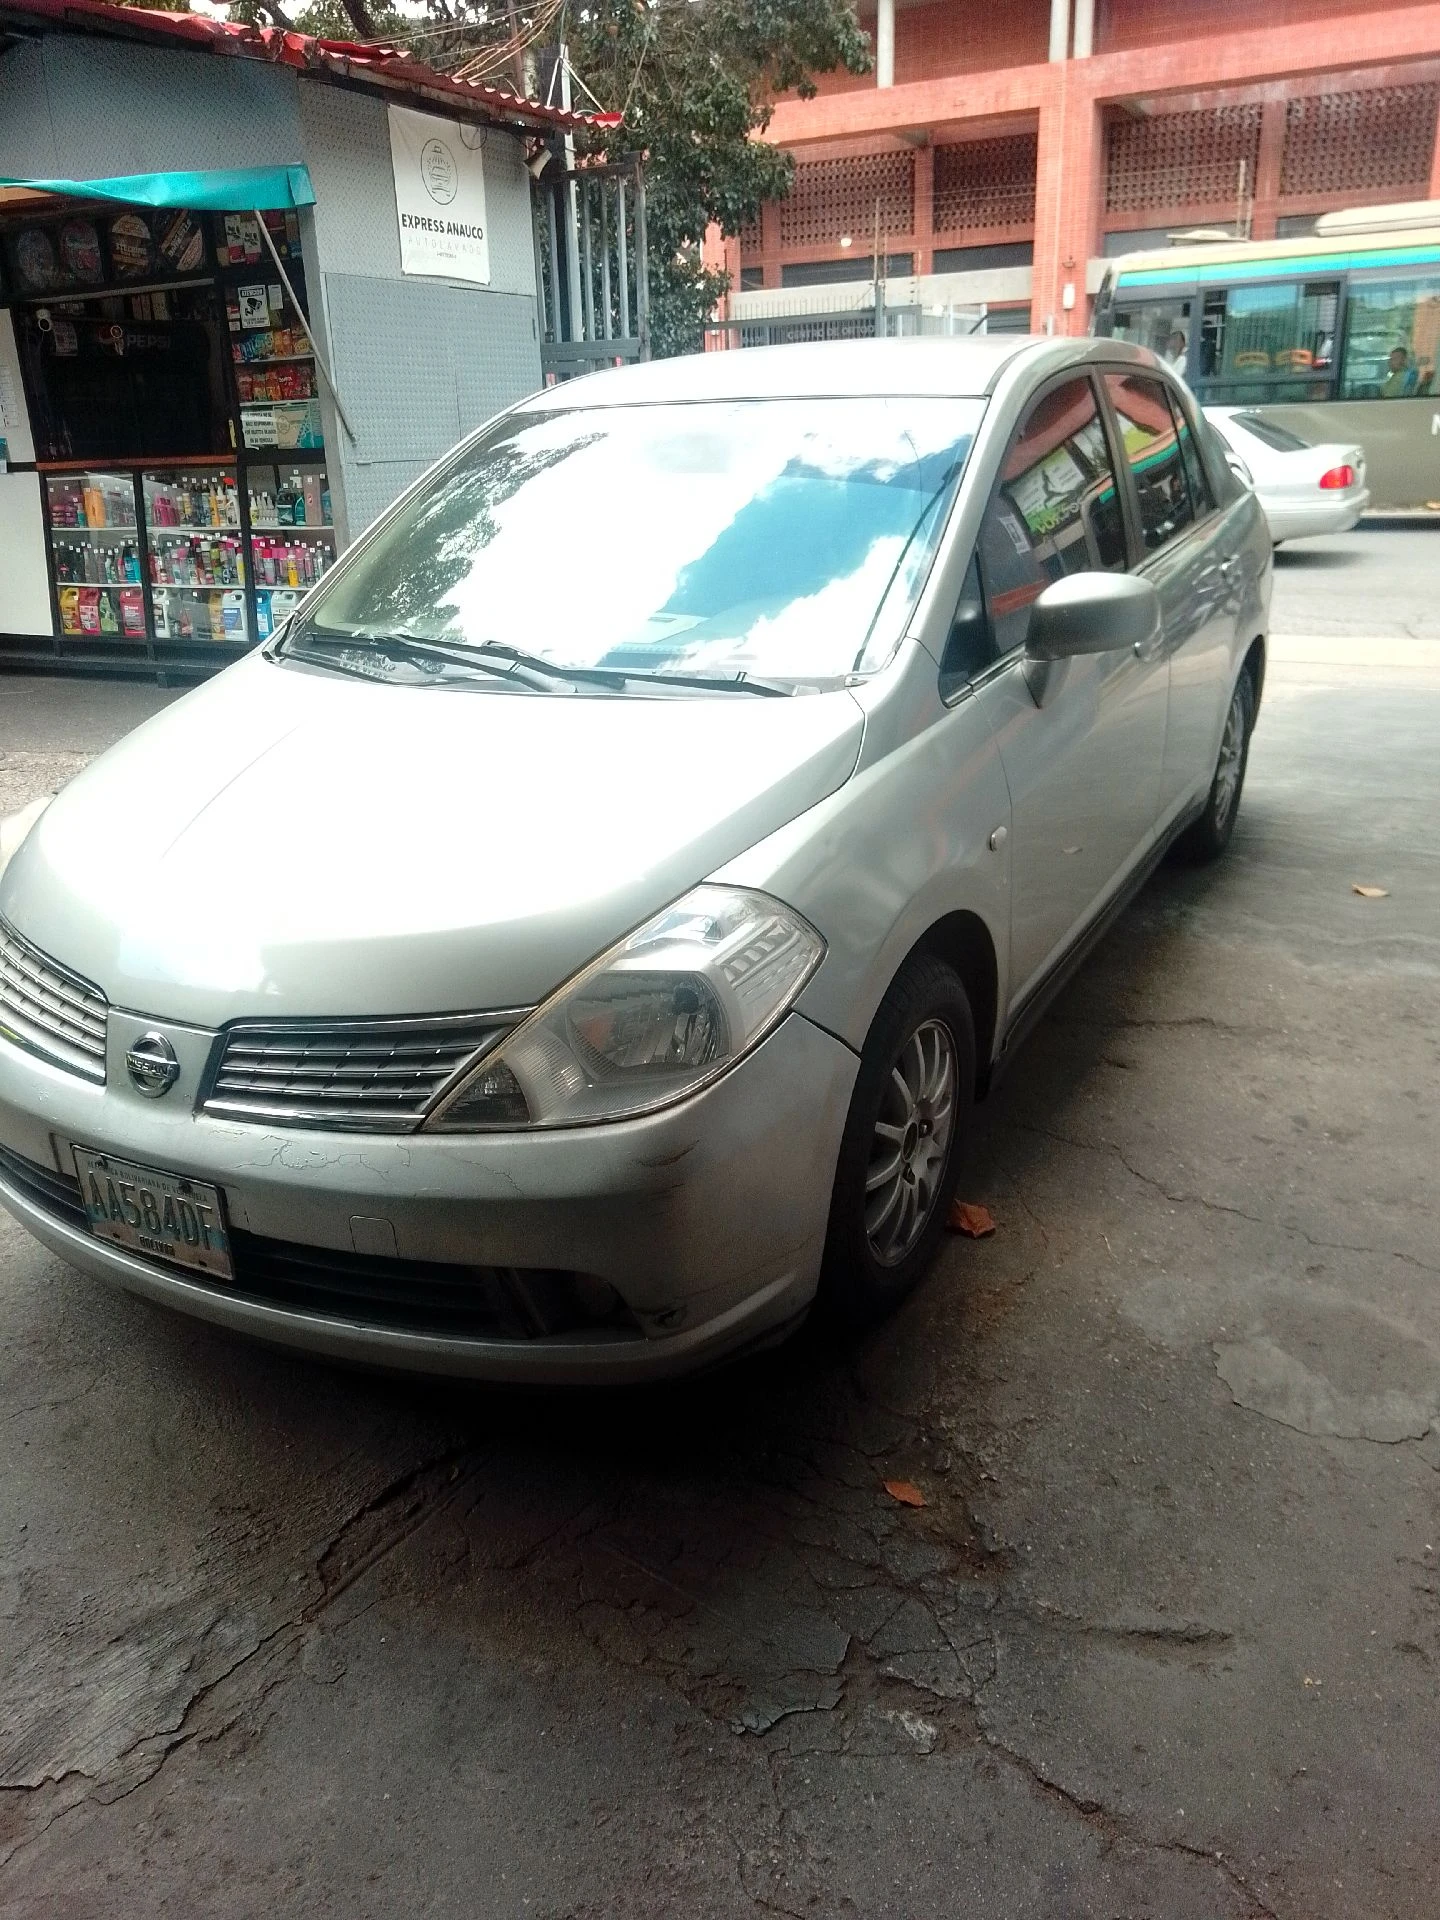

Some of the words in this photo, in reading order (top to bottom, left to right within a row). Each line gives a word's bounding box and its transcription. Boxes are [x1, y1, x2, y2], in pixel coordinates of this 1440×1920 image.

[402, 213, 445, 233] EXPRESS
[447, 221, 484, 240] ANAUCO
[127, 1055, 169, 1077] NISSAN
[161, 1182, 171, 1192] DE
[88, 1170, 214, 1251] AA584DF
